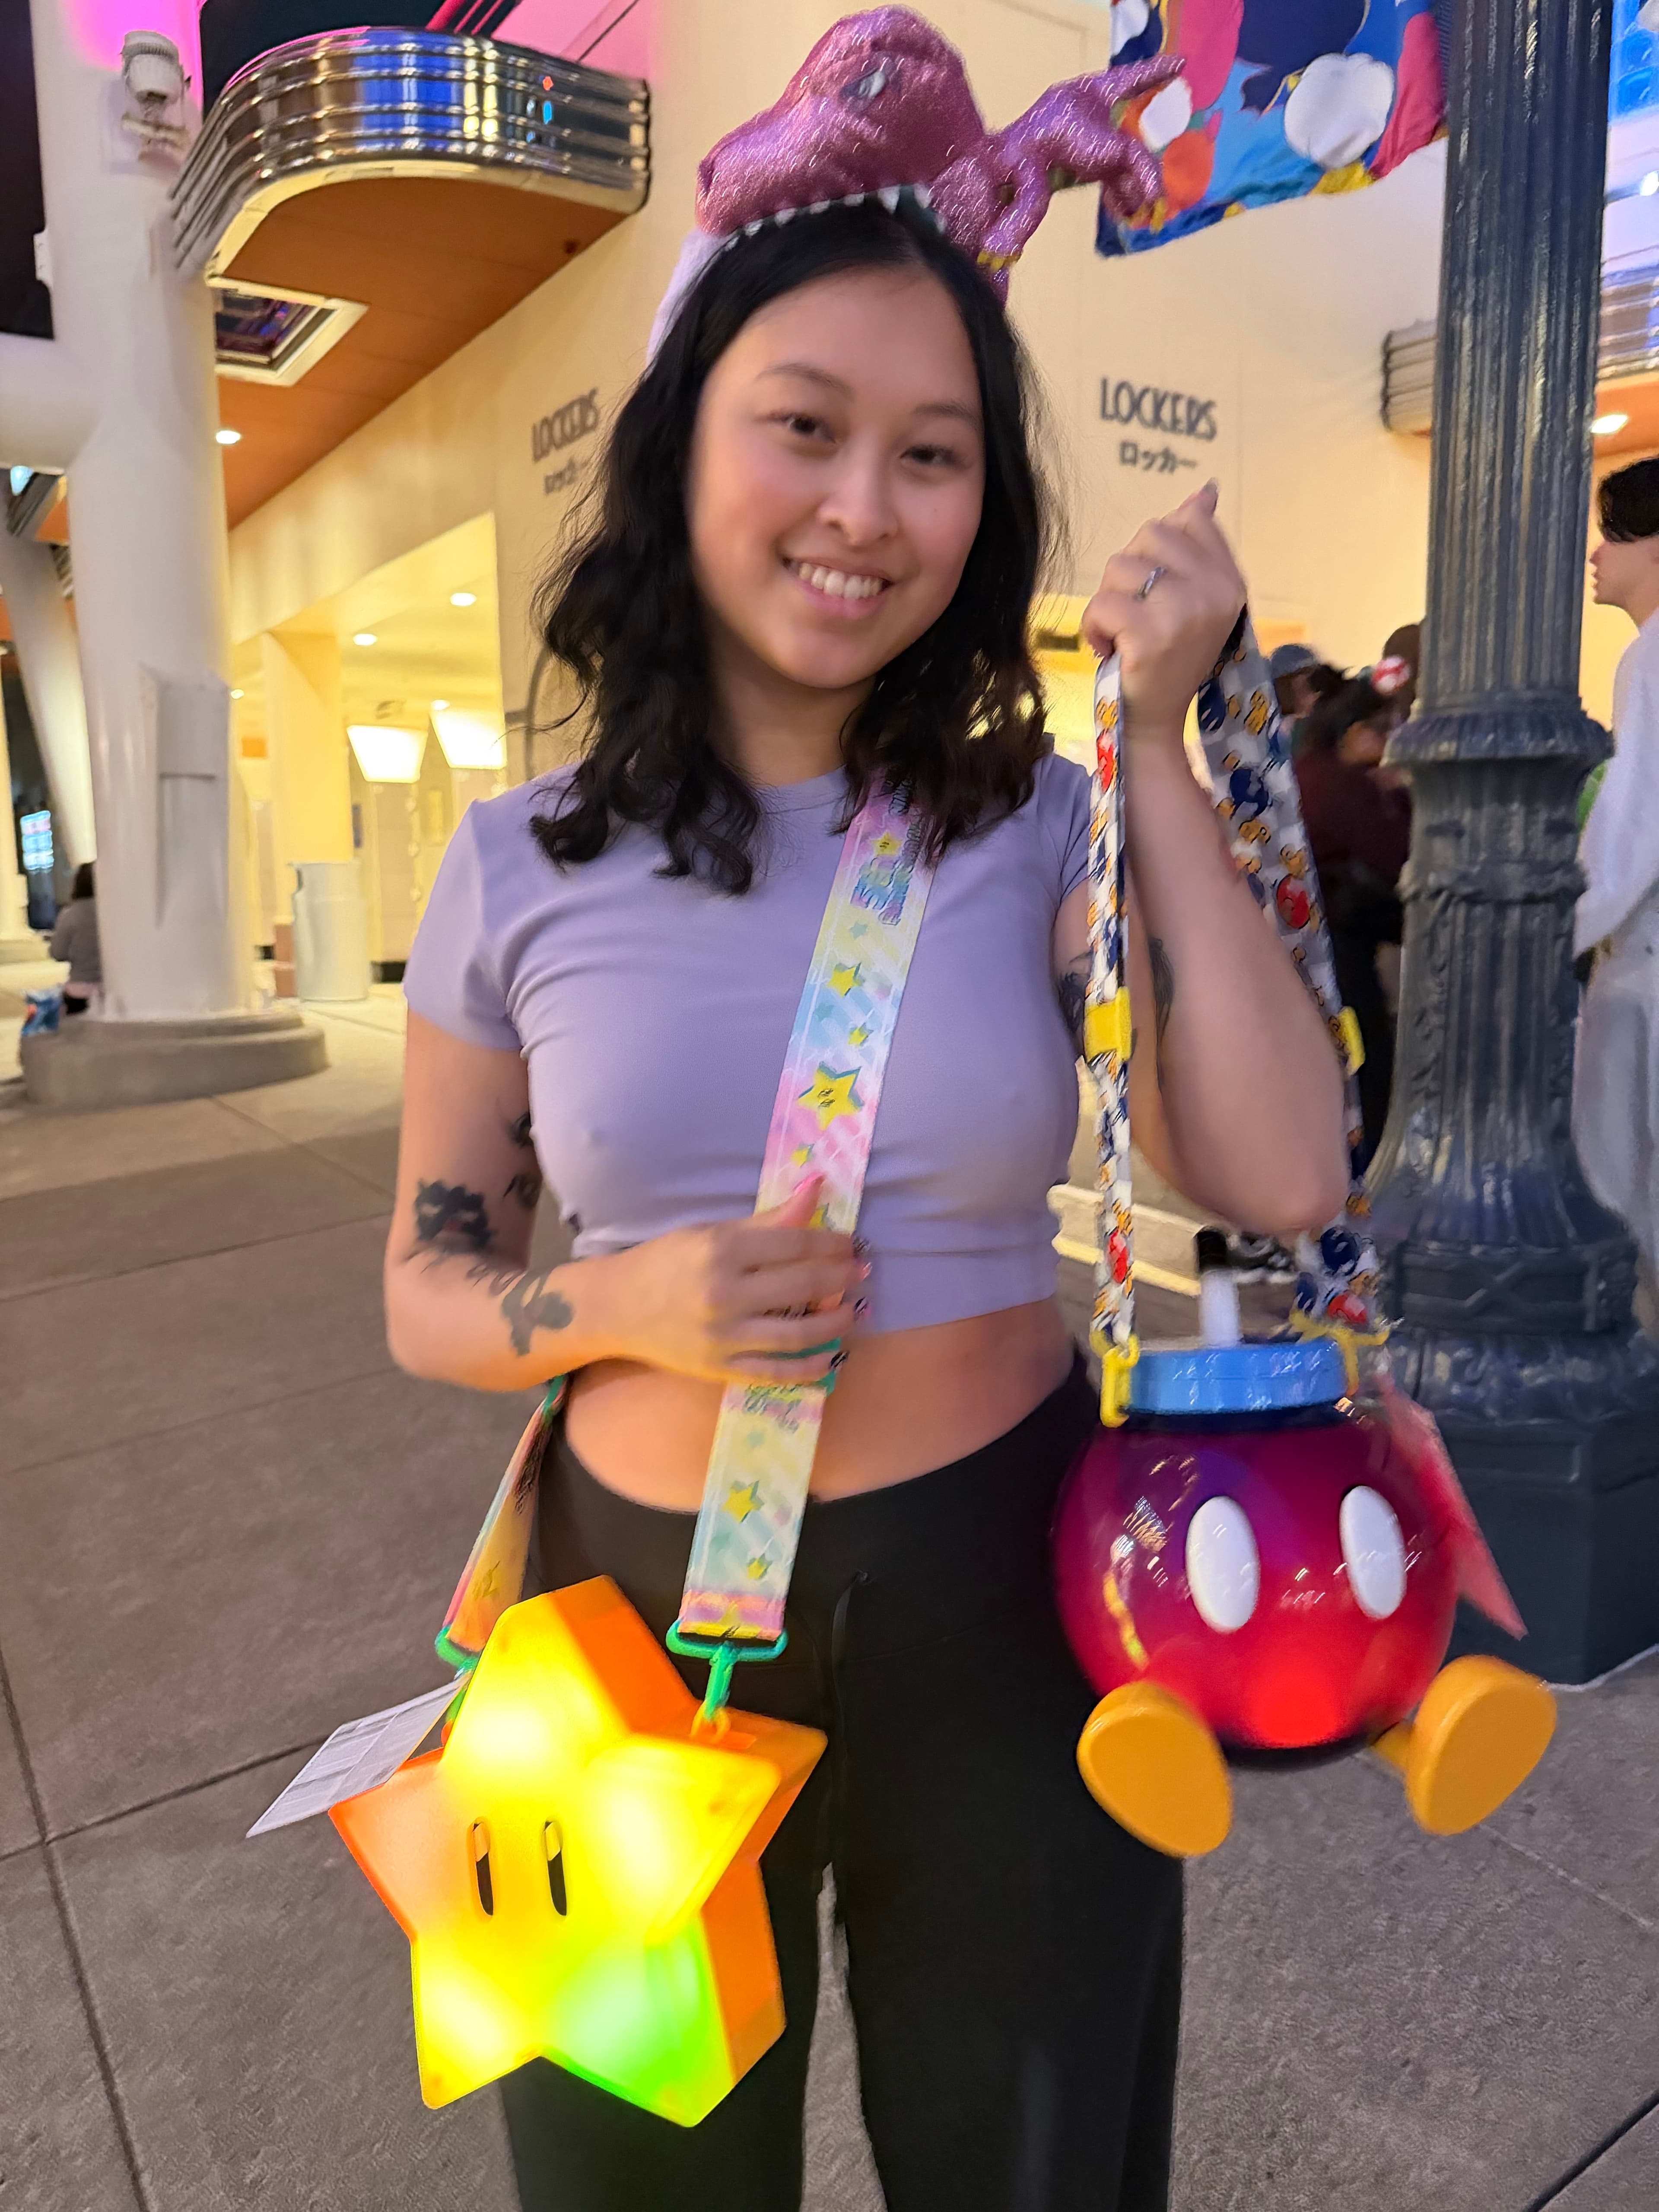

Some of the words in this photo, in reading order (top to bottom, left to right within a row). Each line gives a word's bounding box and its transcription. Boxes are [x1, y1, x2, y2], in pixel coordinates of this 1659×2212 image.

[1101, 377, 1217, 441] LOCKERS
[1120, 440, 1198, 474] ロッカー
